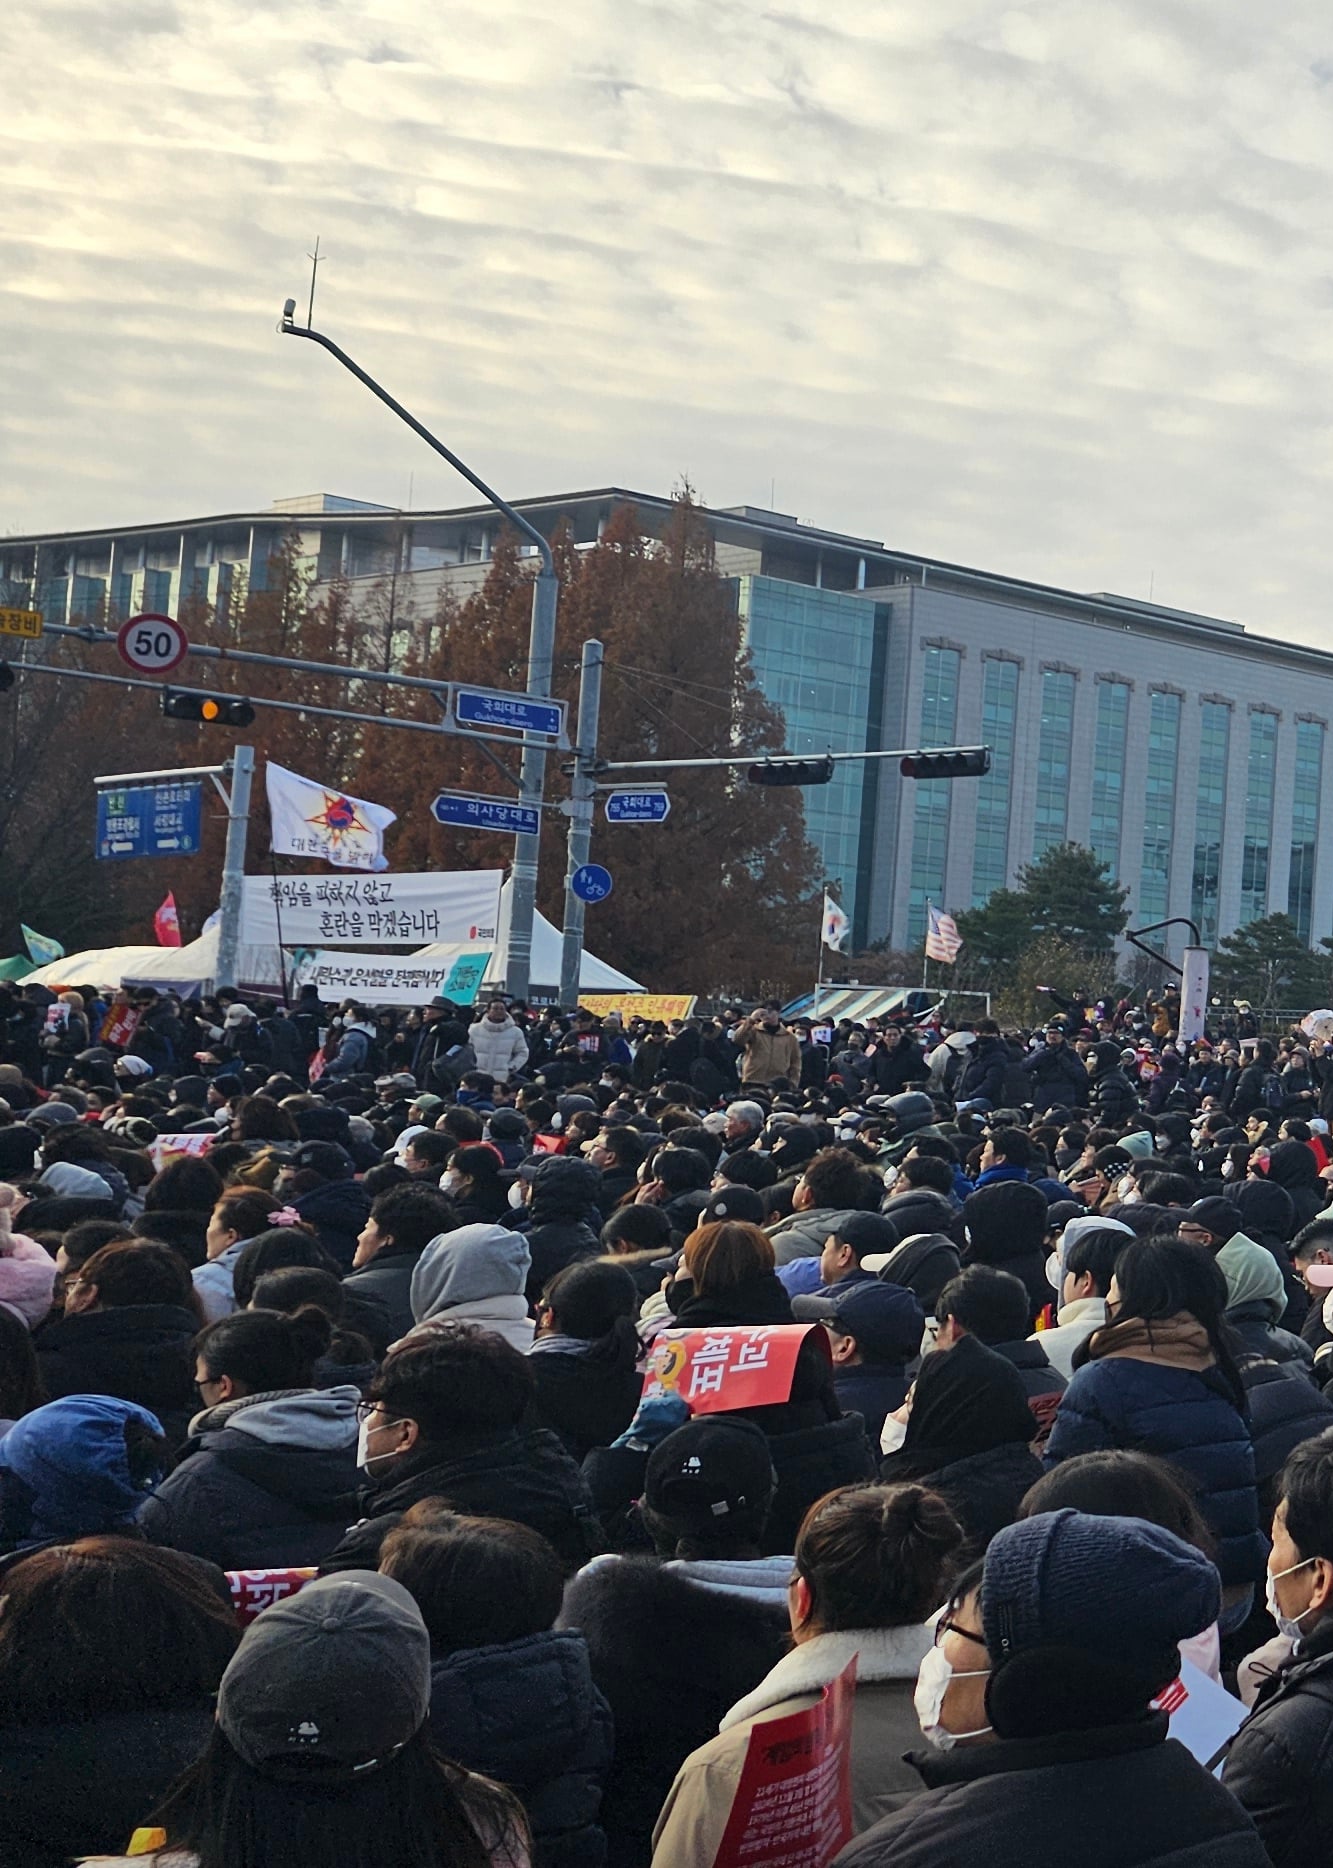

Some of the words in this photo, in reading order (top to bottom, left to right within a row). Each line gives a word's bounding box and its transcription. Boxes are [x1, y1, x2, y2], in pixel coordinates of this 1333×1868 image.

[134, 630, 172, 658] 50
[481, 699, 528, 717] 국회대로
[466, 803, 536, 823] 의사당대로
[622, 796, 652, 808] 국회대로
[269, 881, 312, 908] 책임을
[315, 880, 360, 904] 피하지
[363, 880, 395, 906] 않고
[319, 911, 365, 938] 혼란을
[368, 909, 441, 938] 막겠습니다
[688, 1335, 733, 1398] 체포
